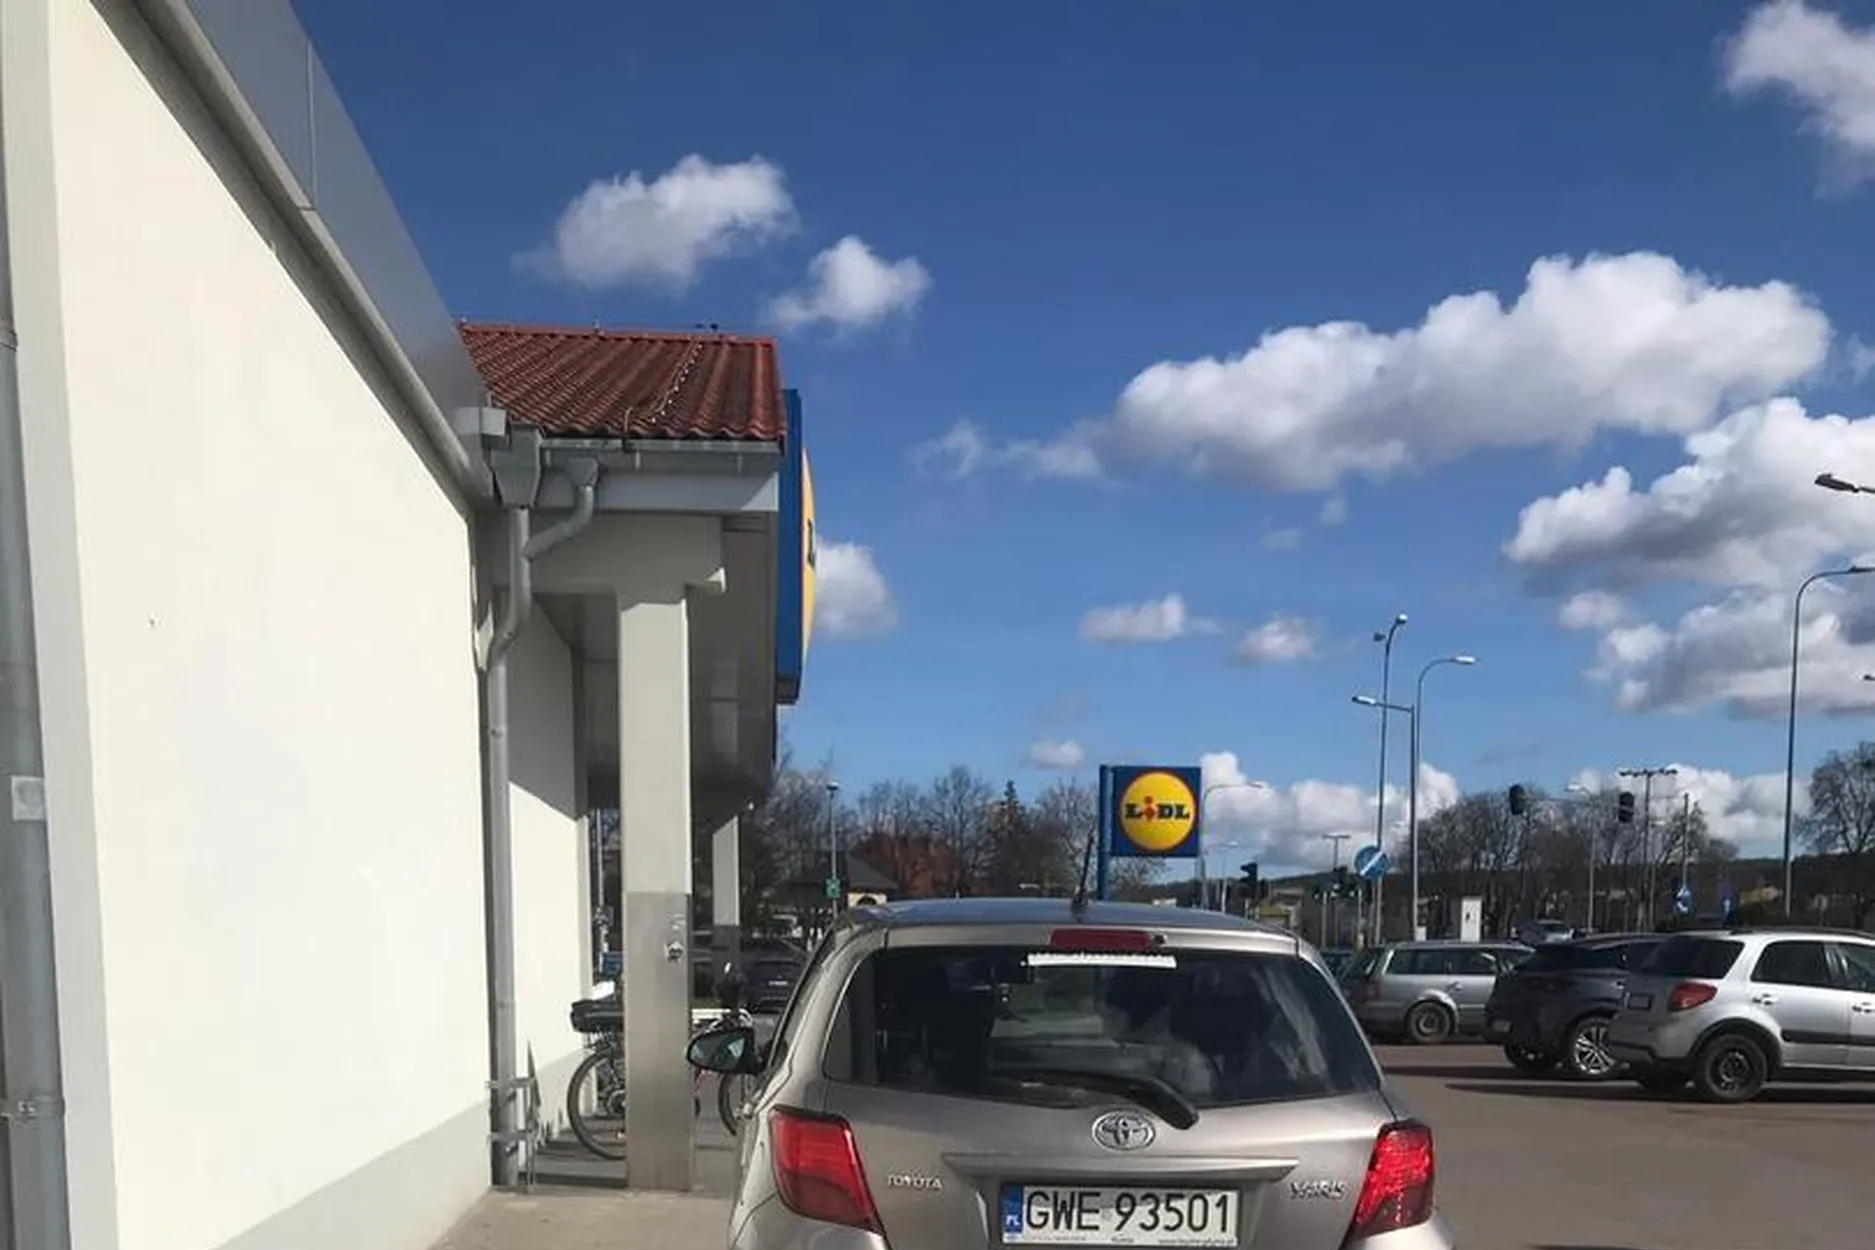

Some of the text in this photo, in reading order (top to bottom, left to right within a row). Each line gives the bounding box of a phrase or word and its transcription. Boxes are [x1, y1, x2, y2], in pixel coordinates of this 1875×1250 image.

[887, 1174, 943, 1190] TOYOTA
[1026, 1190, 1228, 1234] GWE 93501
